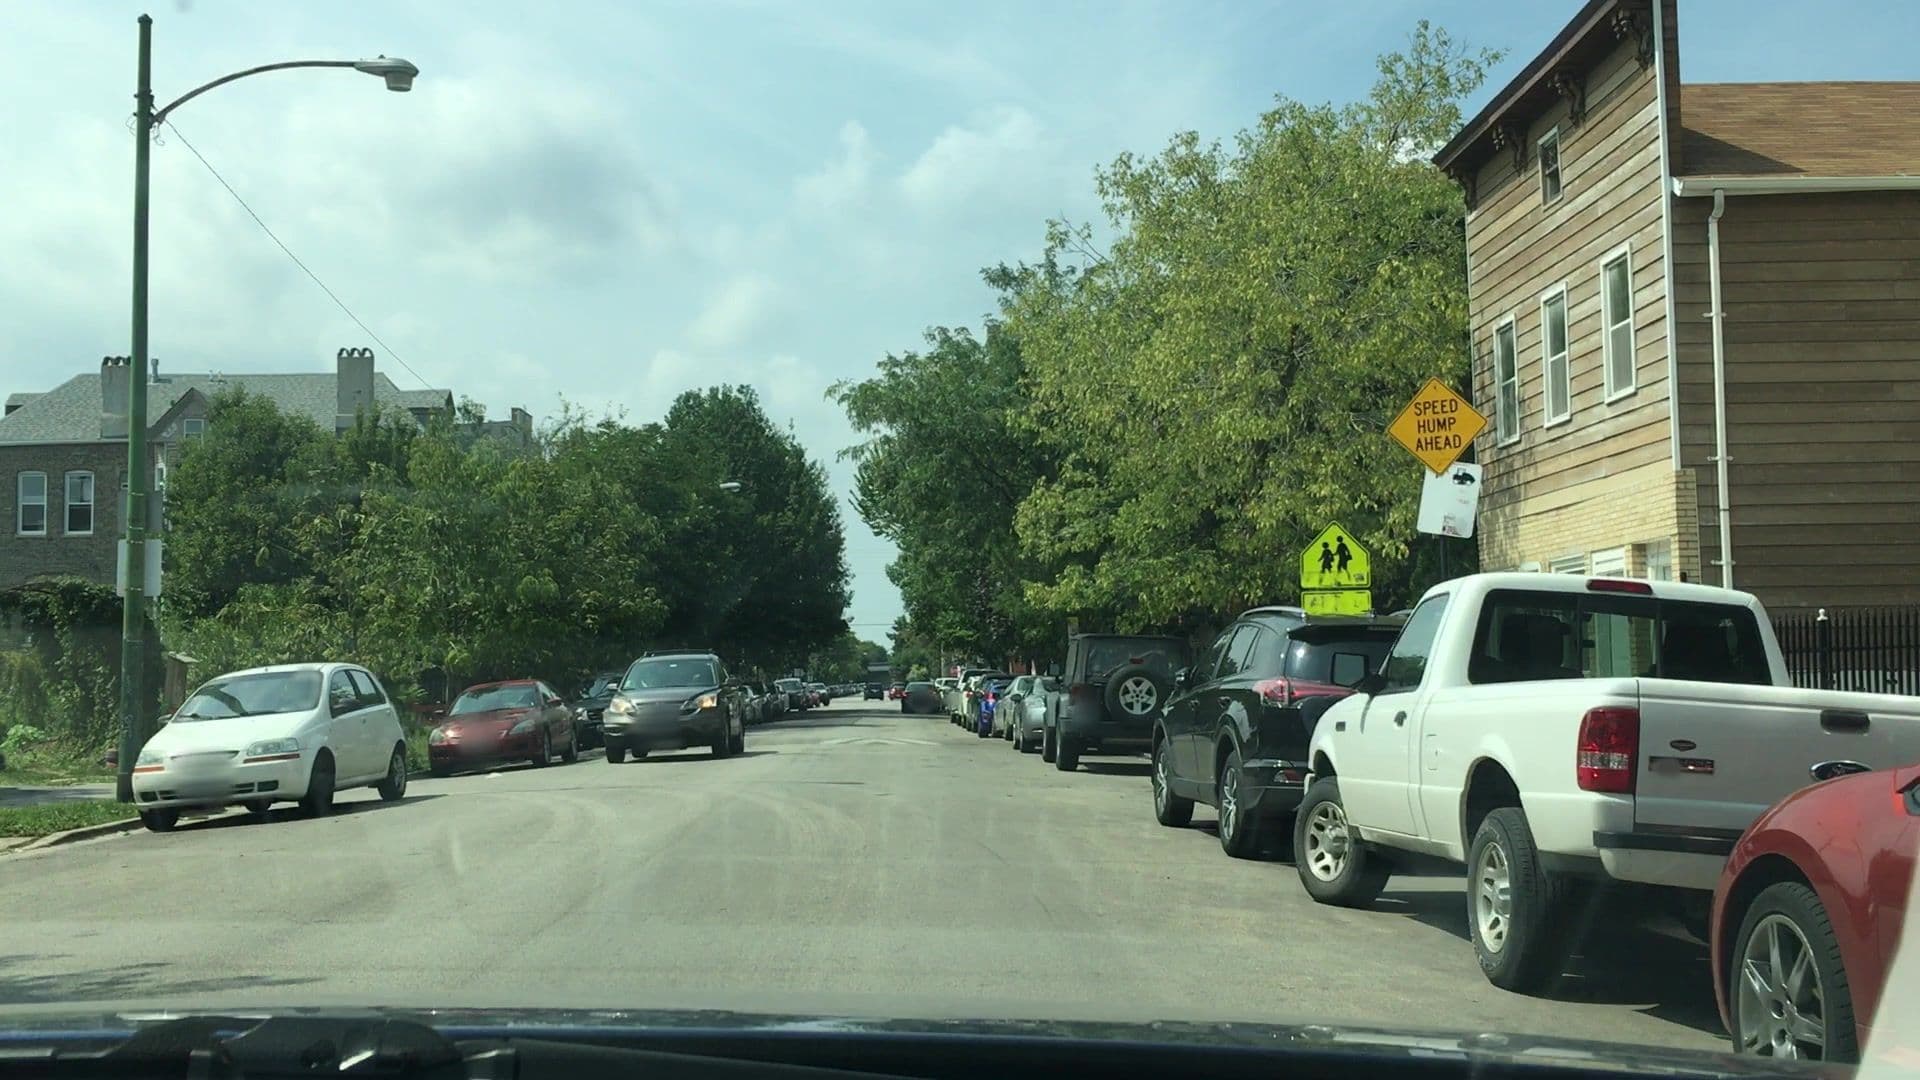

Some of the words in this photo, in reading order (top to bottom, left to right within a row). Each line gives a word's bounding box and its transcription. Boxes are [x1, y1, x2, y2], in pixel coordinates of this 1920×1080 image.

[1414, 399, 1458, 416] SPEED
[1417, 417, 1456, 434] HUMP
[1416, 434, 1461, 451] AHEAD
